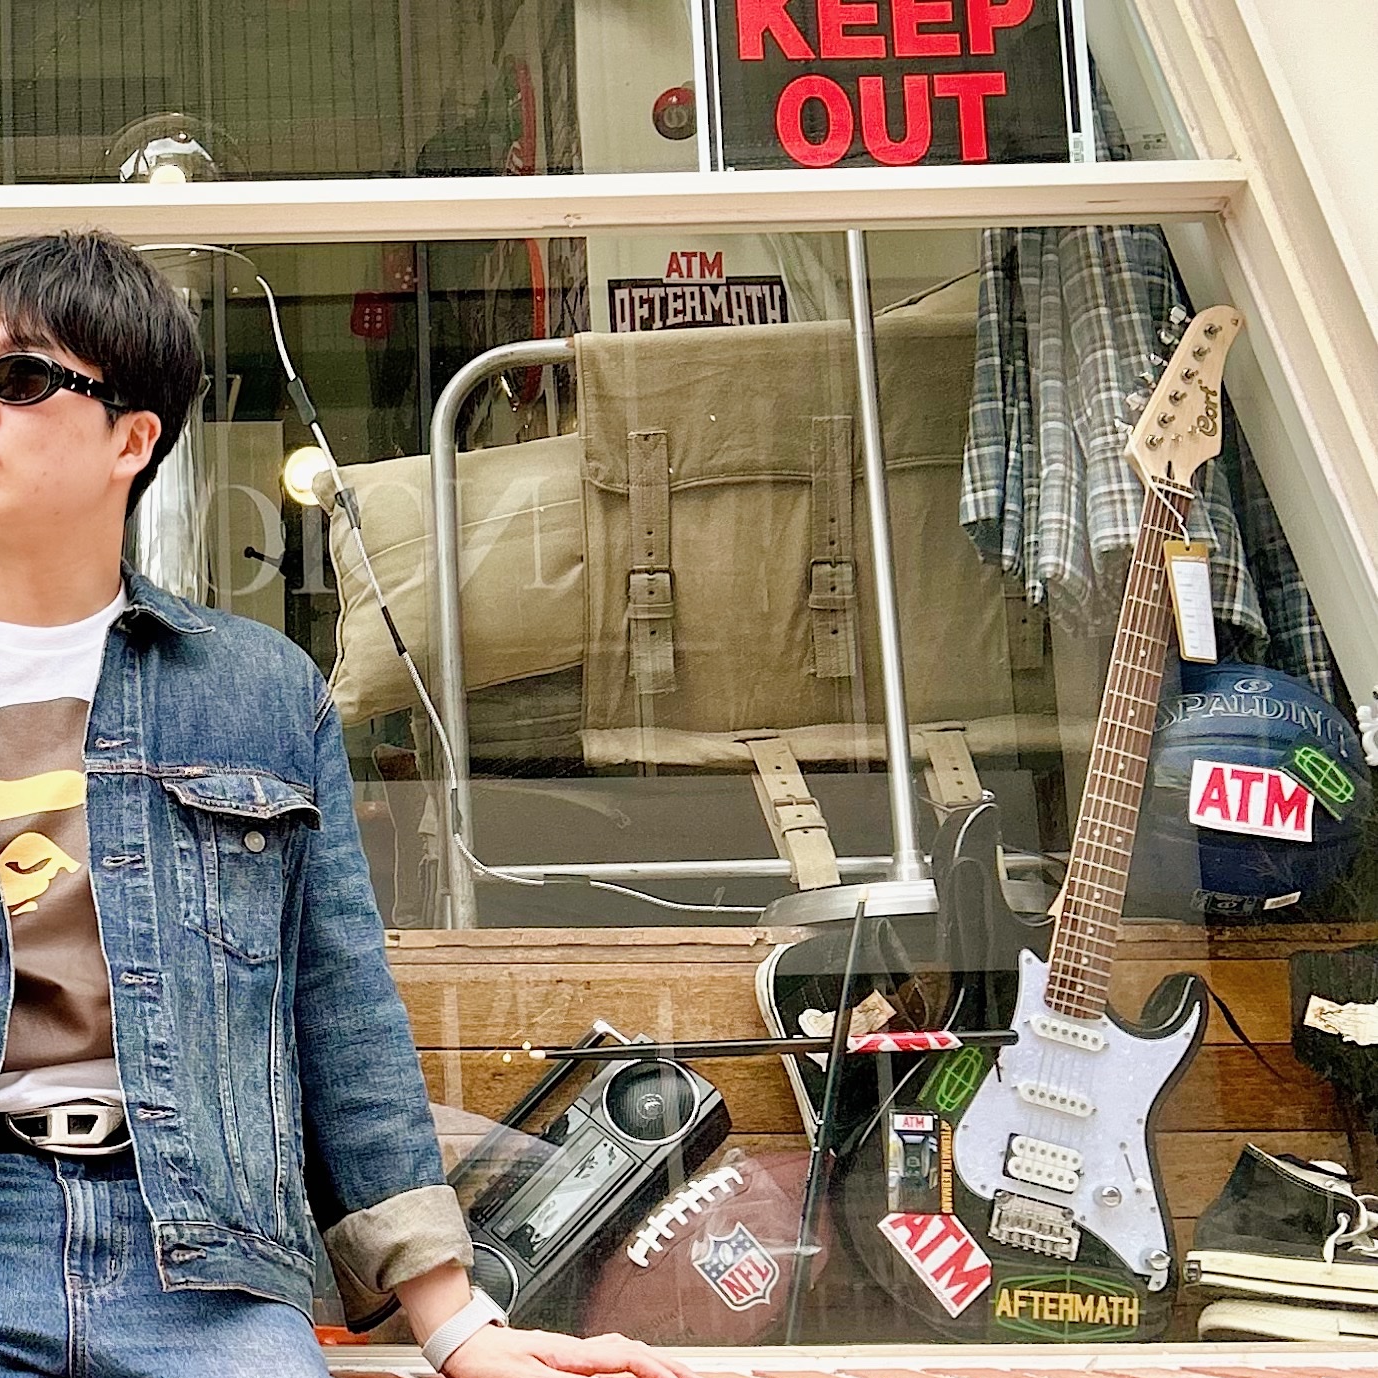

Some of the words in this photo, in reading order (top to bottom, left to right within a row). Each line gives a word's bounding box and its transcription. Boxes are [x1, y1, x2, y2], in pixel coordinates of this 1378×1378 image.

[737, 0, 1034, 62] KEEP
[774, 72, 1007, 168] OUT
[665, 251, 723, 279] ATM
[614, 285, 782, 333] AFTERMATH
[1195, 767, 1311, 832] ATM
[901, 1116, 925, 1129] ATM
[720, 1254, 771, 1302] NFL
[888, 1213, 991, 1308] ATM
[995, 1287, 1140, 1328] AFTERMATH
